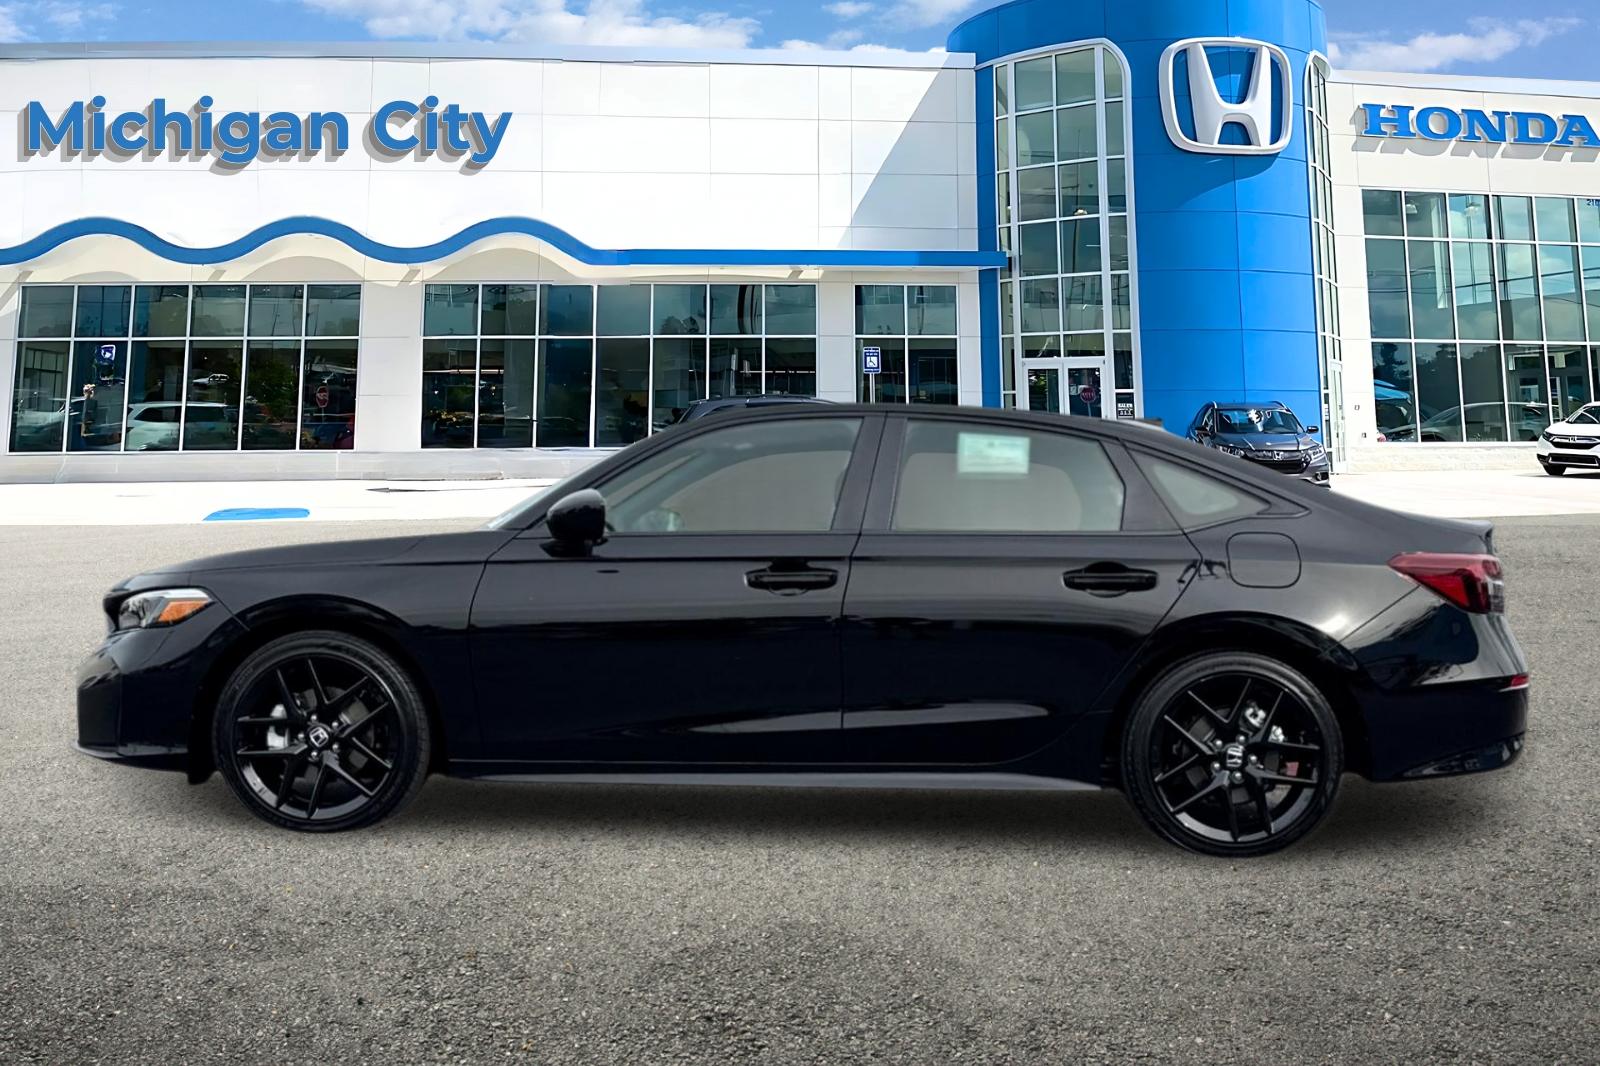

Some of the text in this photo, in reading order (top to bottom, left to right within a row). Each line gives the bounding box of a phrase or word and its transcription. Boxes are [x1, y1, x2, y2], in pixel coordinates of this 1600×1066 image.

[27, 95, 513, 164] Michigan City
[1361, 103, 1600, 147] HONDA
